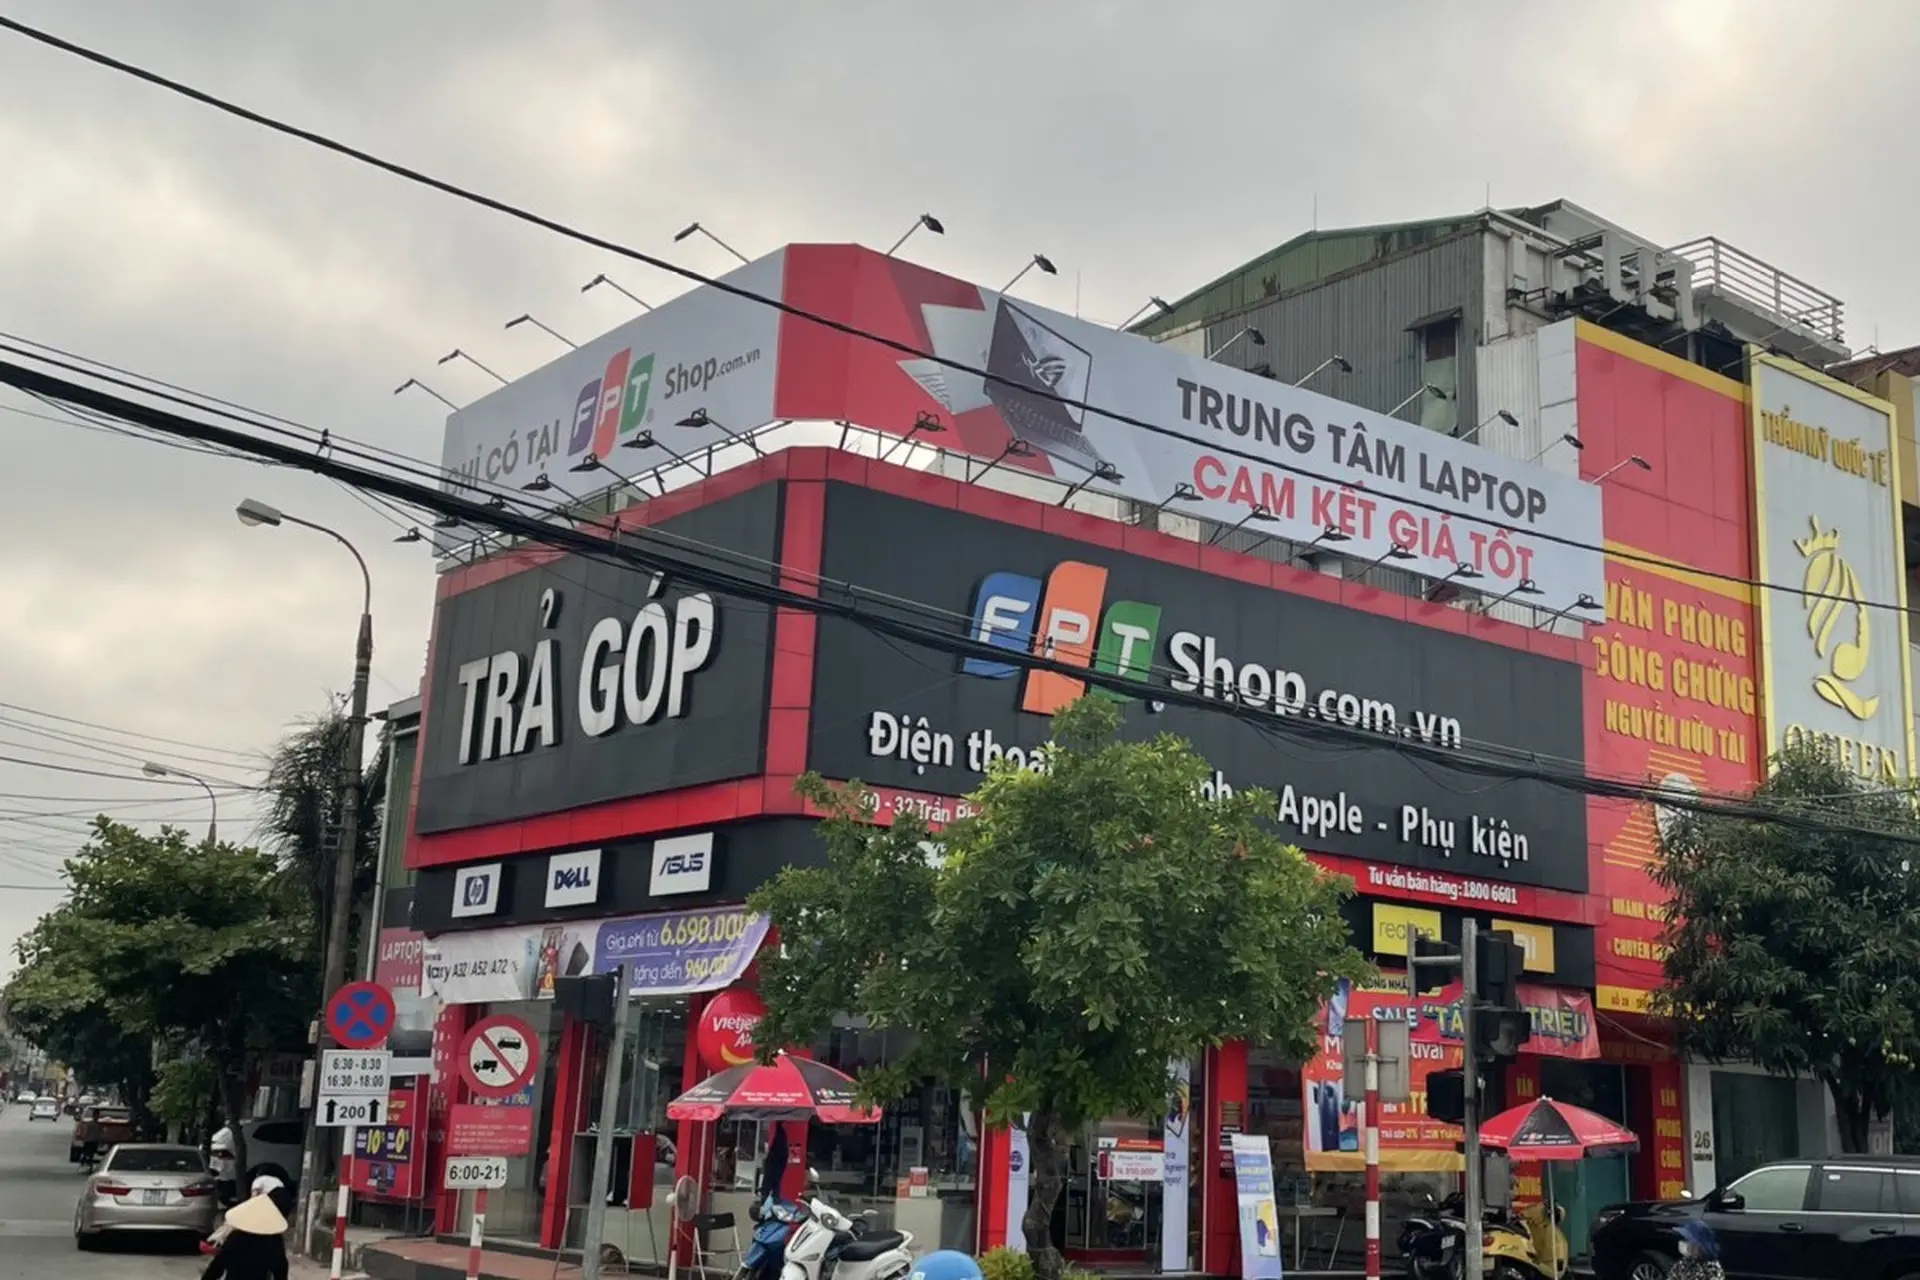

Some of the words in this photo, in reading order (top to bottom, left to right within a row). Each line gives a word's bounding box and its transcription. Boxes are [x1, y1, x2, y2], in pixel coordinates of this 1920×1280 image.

[664, 347, 762, 400] Shop.com.vn
[486, 429, 519, 483] CÓ
[526, 417, 560, 471] TẠI
[1177, 377, 1315, 454] TRUNG
[1327, 421, 1406, 484] TÂM
[1418, 452, 1548, 524] LAPTOP
[1193, 455, 1296, 520] CAM
[1311, 481, 1377, 540] KẾT
[1388, 510, 1458, 565] GIÁ
[1468, 525, 1535, 582] TỐT
[976, 594, 1152, 677] FPT
[1663, 600, 1747, 658] PHÒNG
[458, 588, 560, 765] TRẢ
[577, 570, 717, 738] GÓP
[1168, 629, 1464, 751] Shop.com.vn
[1591, 631, 1665, 692] CÔNG
[1671, 656, 1756, 717] CHỨNG
[1604, 698, 1676, 747] NGUYỄN
[1716, 724, 1747, 765] TÀI
[869, 710, 954, 776] Điện
[1278, 783, 1364, 838] Apple
[1402, 804, 1456, 857] Phụ
[1471, 814, 1530, 868] kiện
[554, 866, 591, 892] DELL
[658, 852, 705, 877] ASUS
[1368, 865, 1385, 885] Tư
[1385, 865, 1407, 888] vấn
[1407, 871, 1430, 891] bán
[1491, 884, 1518, 905] 6601
[1379, 918, 1436, 943] reame
[1410, 1042, 1445, 1060] tival
[327, 1075, 352, 1088] 16:30
[359, 1076, 384, 1089] 18:00
[339, 1105, 366, 1119] 200
[1694, 1130, 1711, 1149] 26
